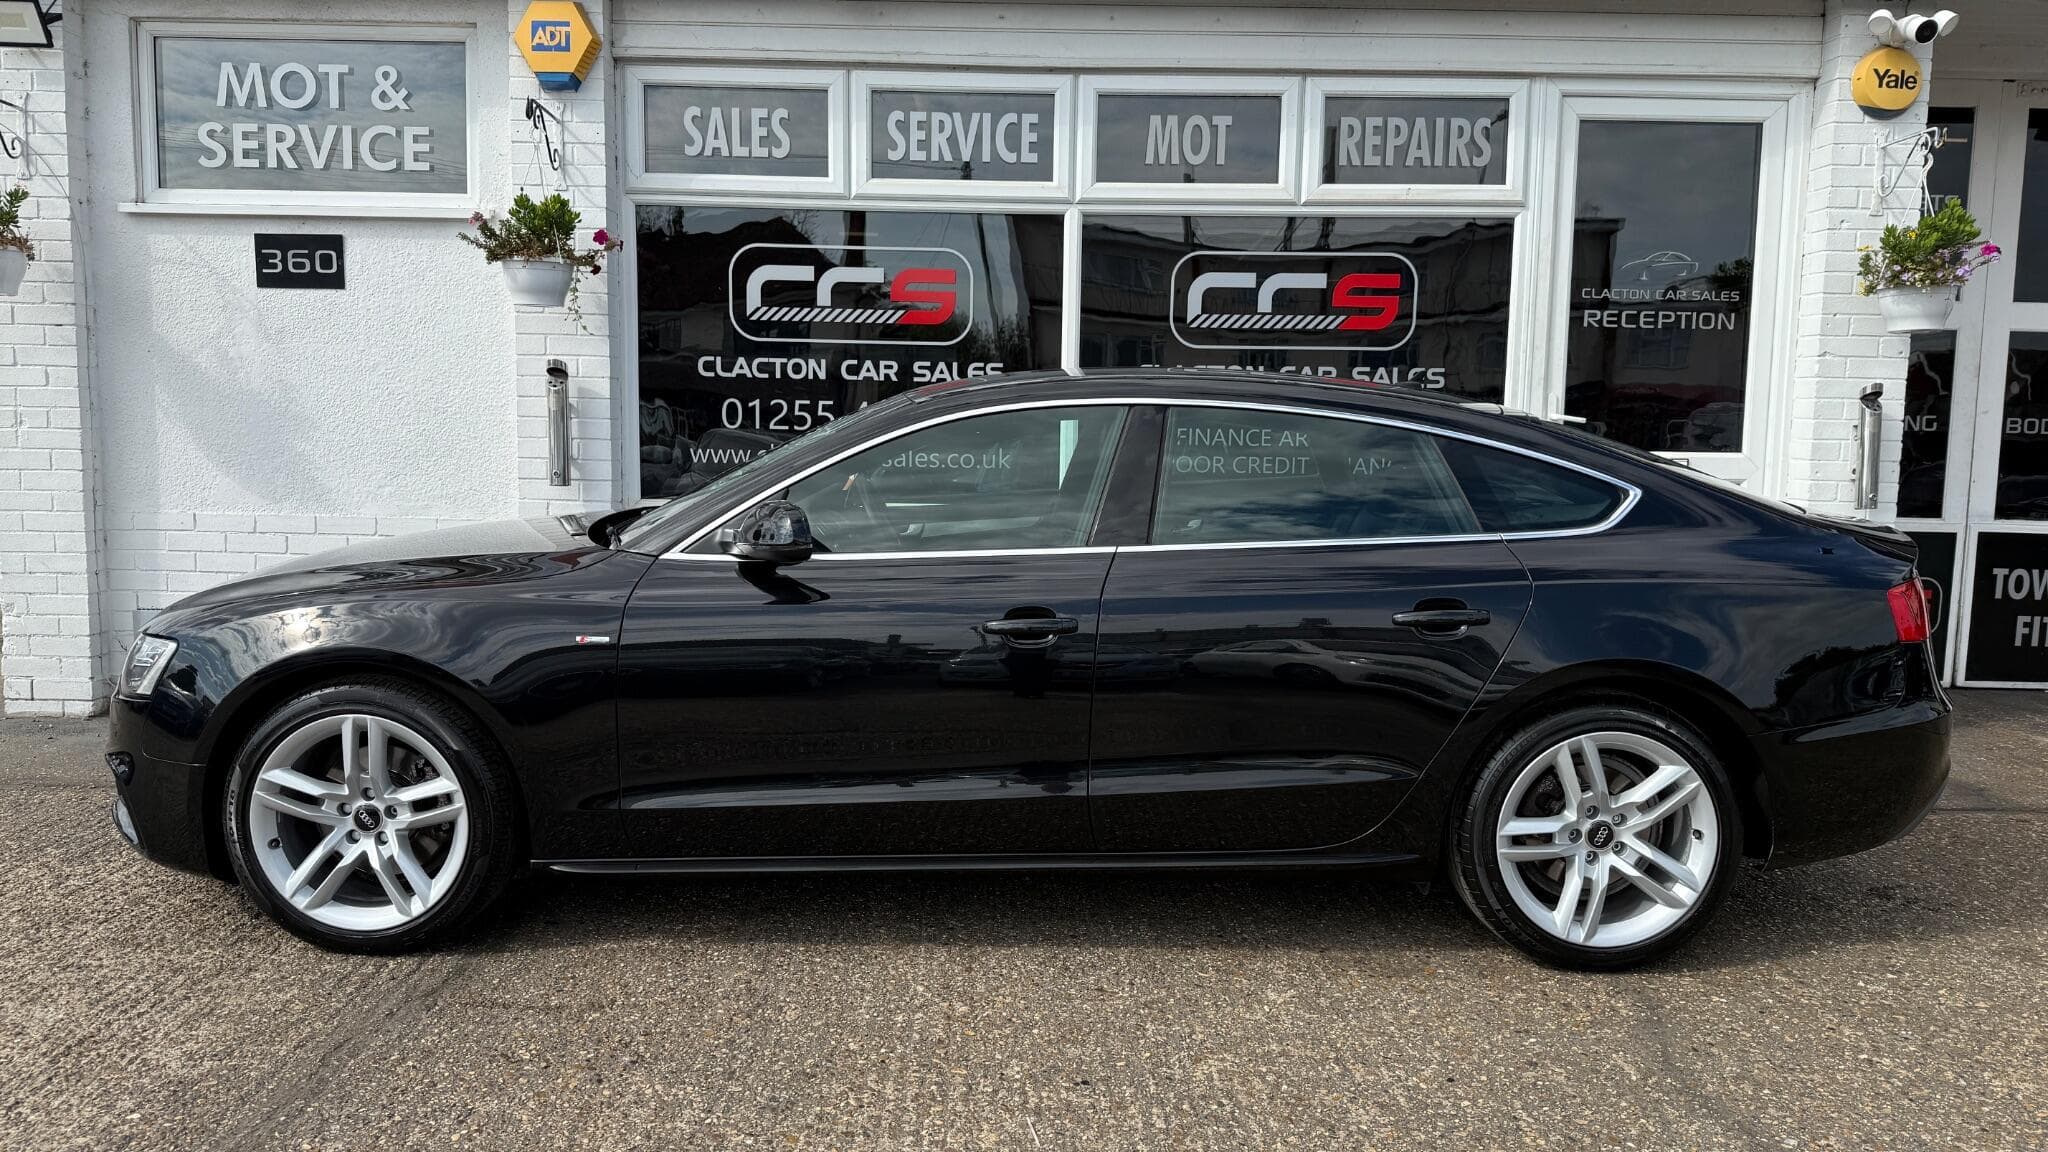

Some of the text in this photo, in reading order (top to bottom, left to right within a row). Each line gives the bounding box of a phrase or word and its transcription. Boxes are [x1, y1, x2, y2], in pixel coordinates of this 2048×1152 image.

[531, 26, 571, 47] ADT
[216, 62, 411, 111] MOT &
[1873, 68, 1918, 90] Yale
[683, 105, 791, 159] SALES
[886, 110, 1039, 164] SERVICE
[1145, 114, 1233, 166] MOT
[1338, 116, 1493, 168] REPAIRS
[197, 122, 432, 171] SERVICE
[261, 249, 339, 274] 360
[1582, 288, 1740, 302] CLACTON CAR SALES
[1583, 309, 1735, 330] RECEPTION
[697, 355, 1004, 382] CLACTON CAR SALES
[1177, 428, 1272, 447] FINANCE
[1172, 456, 1225, 474] OOR
[1232, 456, 1310, 474] CREDIT
